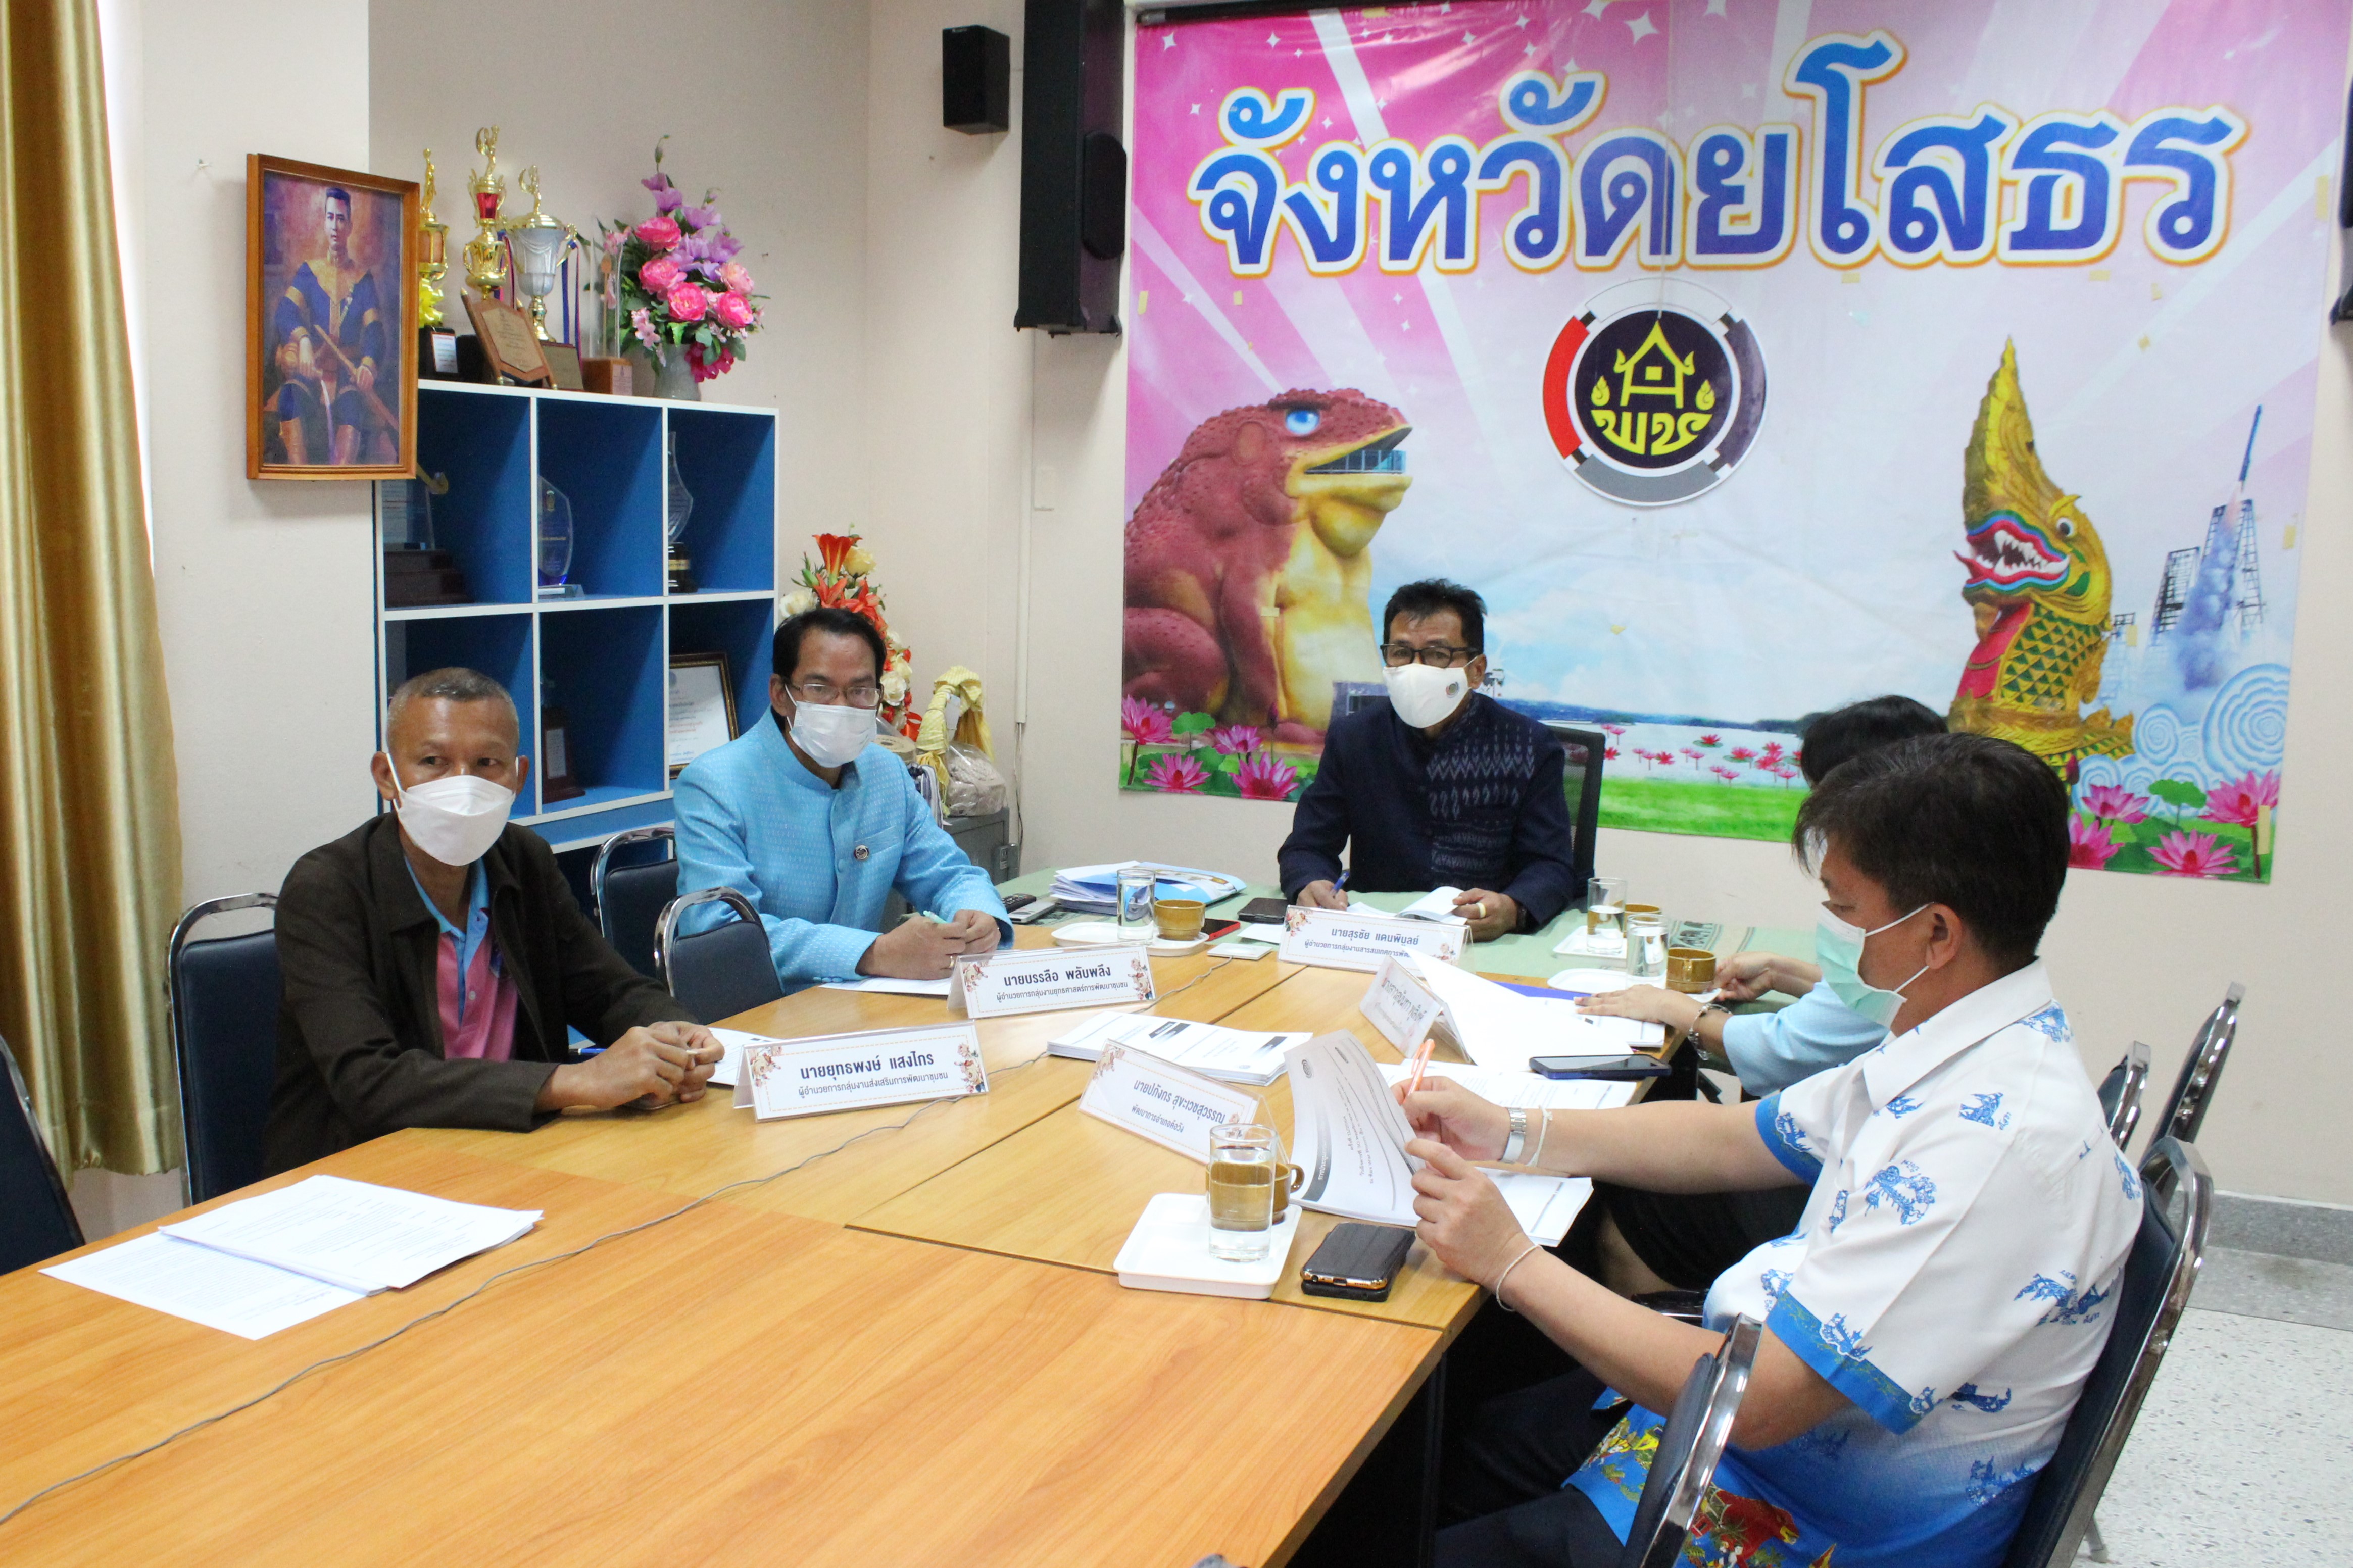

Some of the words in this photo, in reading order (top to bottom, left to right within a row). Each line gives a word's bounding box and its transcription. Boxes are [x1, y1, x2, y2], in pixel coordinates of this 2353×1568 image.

[1191, 31, 2243, 270] จังหวัดยโสธร
[1331, 928, 1370, 941] นายสุรชัย
[1004, 969, 1059, 986] นายบรรลือ
[1065, 964, 1111, 980] พลับพลึง
[996, 981, 1128, 1003] ผู้อำนวยการกลุ่มงานยุทธศาสตร์การพัฒนาชุมชน
[800, 1055, 881, 1081] นายยุทธพงษ์
[889, 1051, 934, 1070] แสงไกร
[798, 1071, 948, 1099] ผู้อำนวยการกลุ่มงานส่งเสริมการพัฒนาชุมชน
[1131, 1104, 1185, 1133] พัฒนาการอำเภอค้อวัง
[1172, 1095, 1226, 1125] สุขะเวชสุวรรณ
